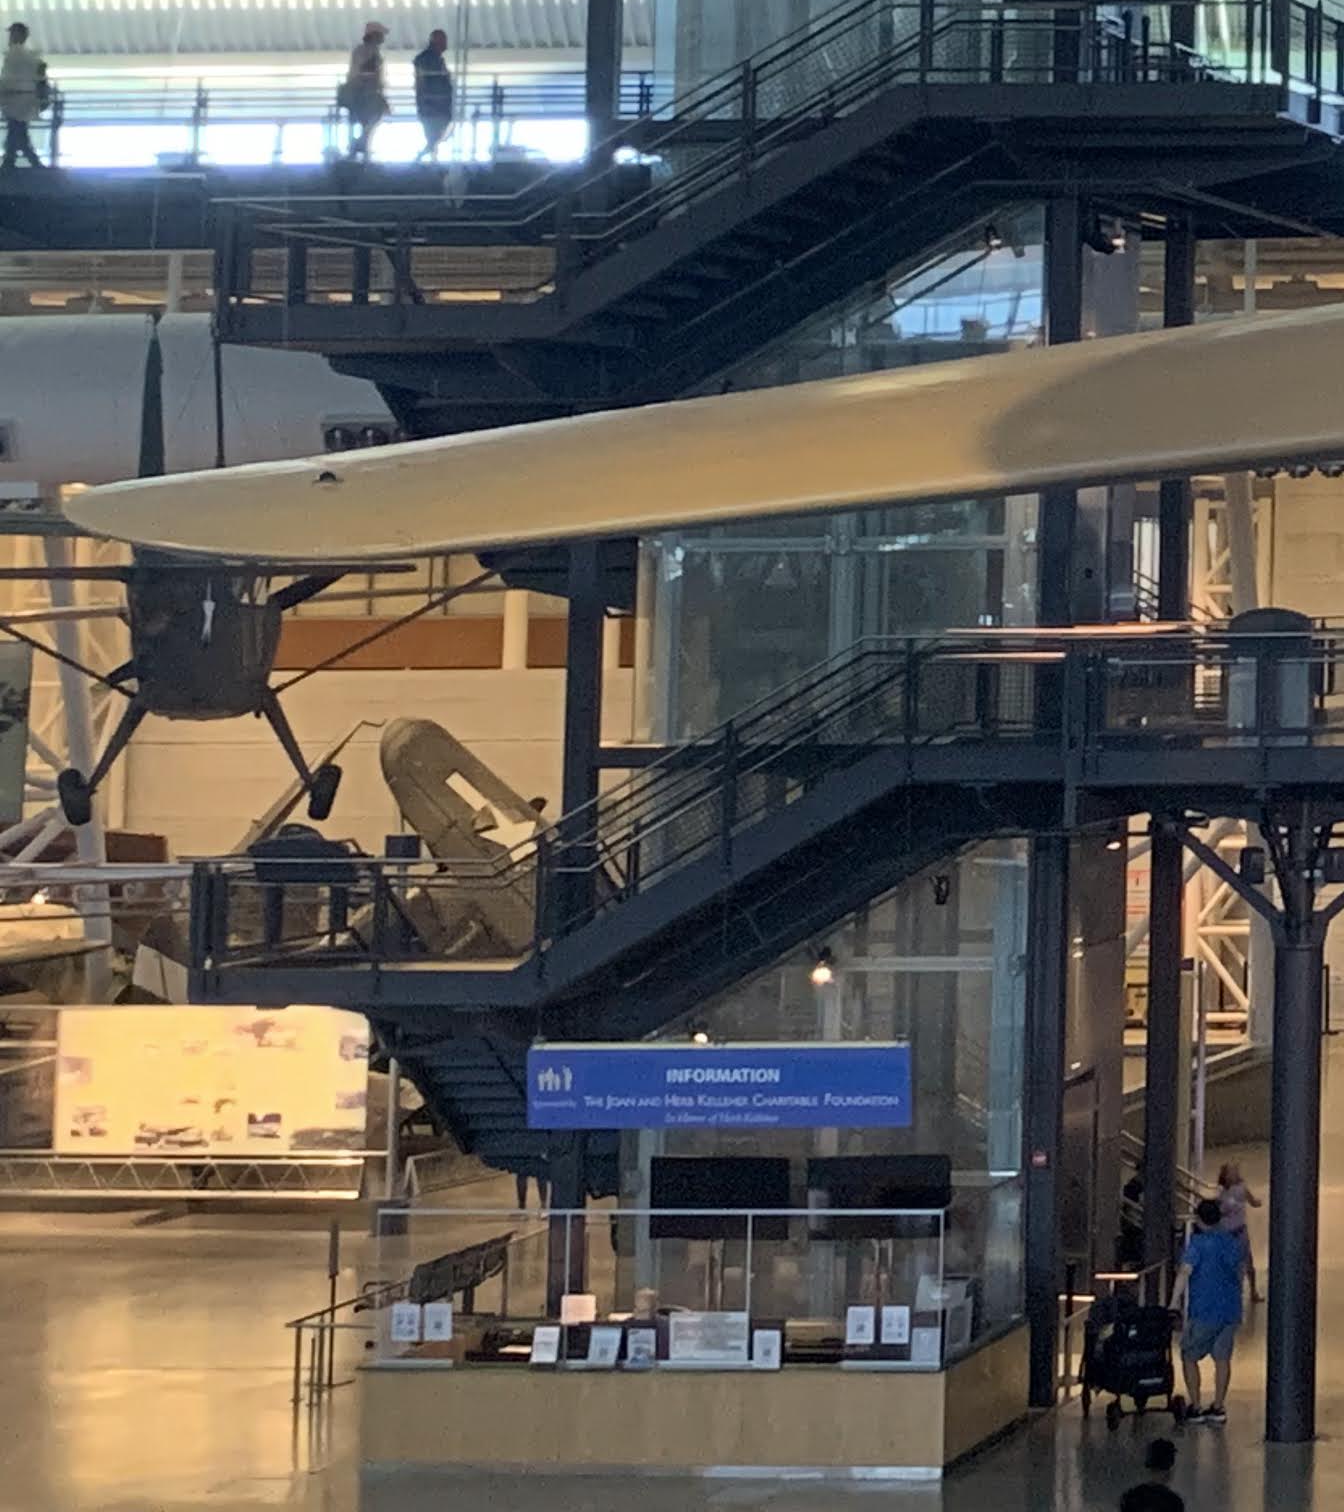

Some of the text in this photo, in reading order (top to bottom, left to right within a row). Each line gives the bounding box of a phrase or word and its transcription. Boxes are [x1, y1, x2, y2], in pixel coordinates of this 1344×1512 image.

[665, 1068, 781, 1083] INFORMATION
[752, 1093, 818, 1107] CHARITABLE
[823, 1092, 899, 1106] FOUNDATION
